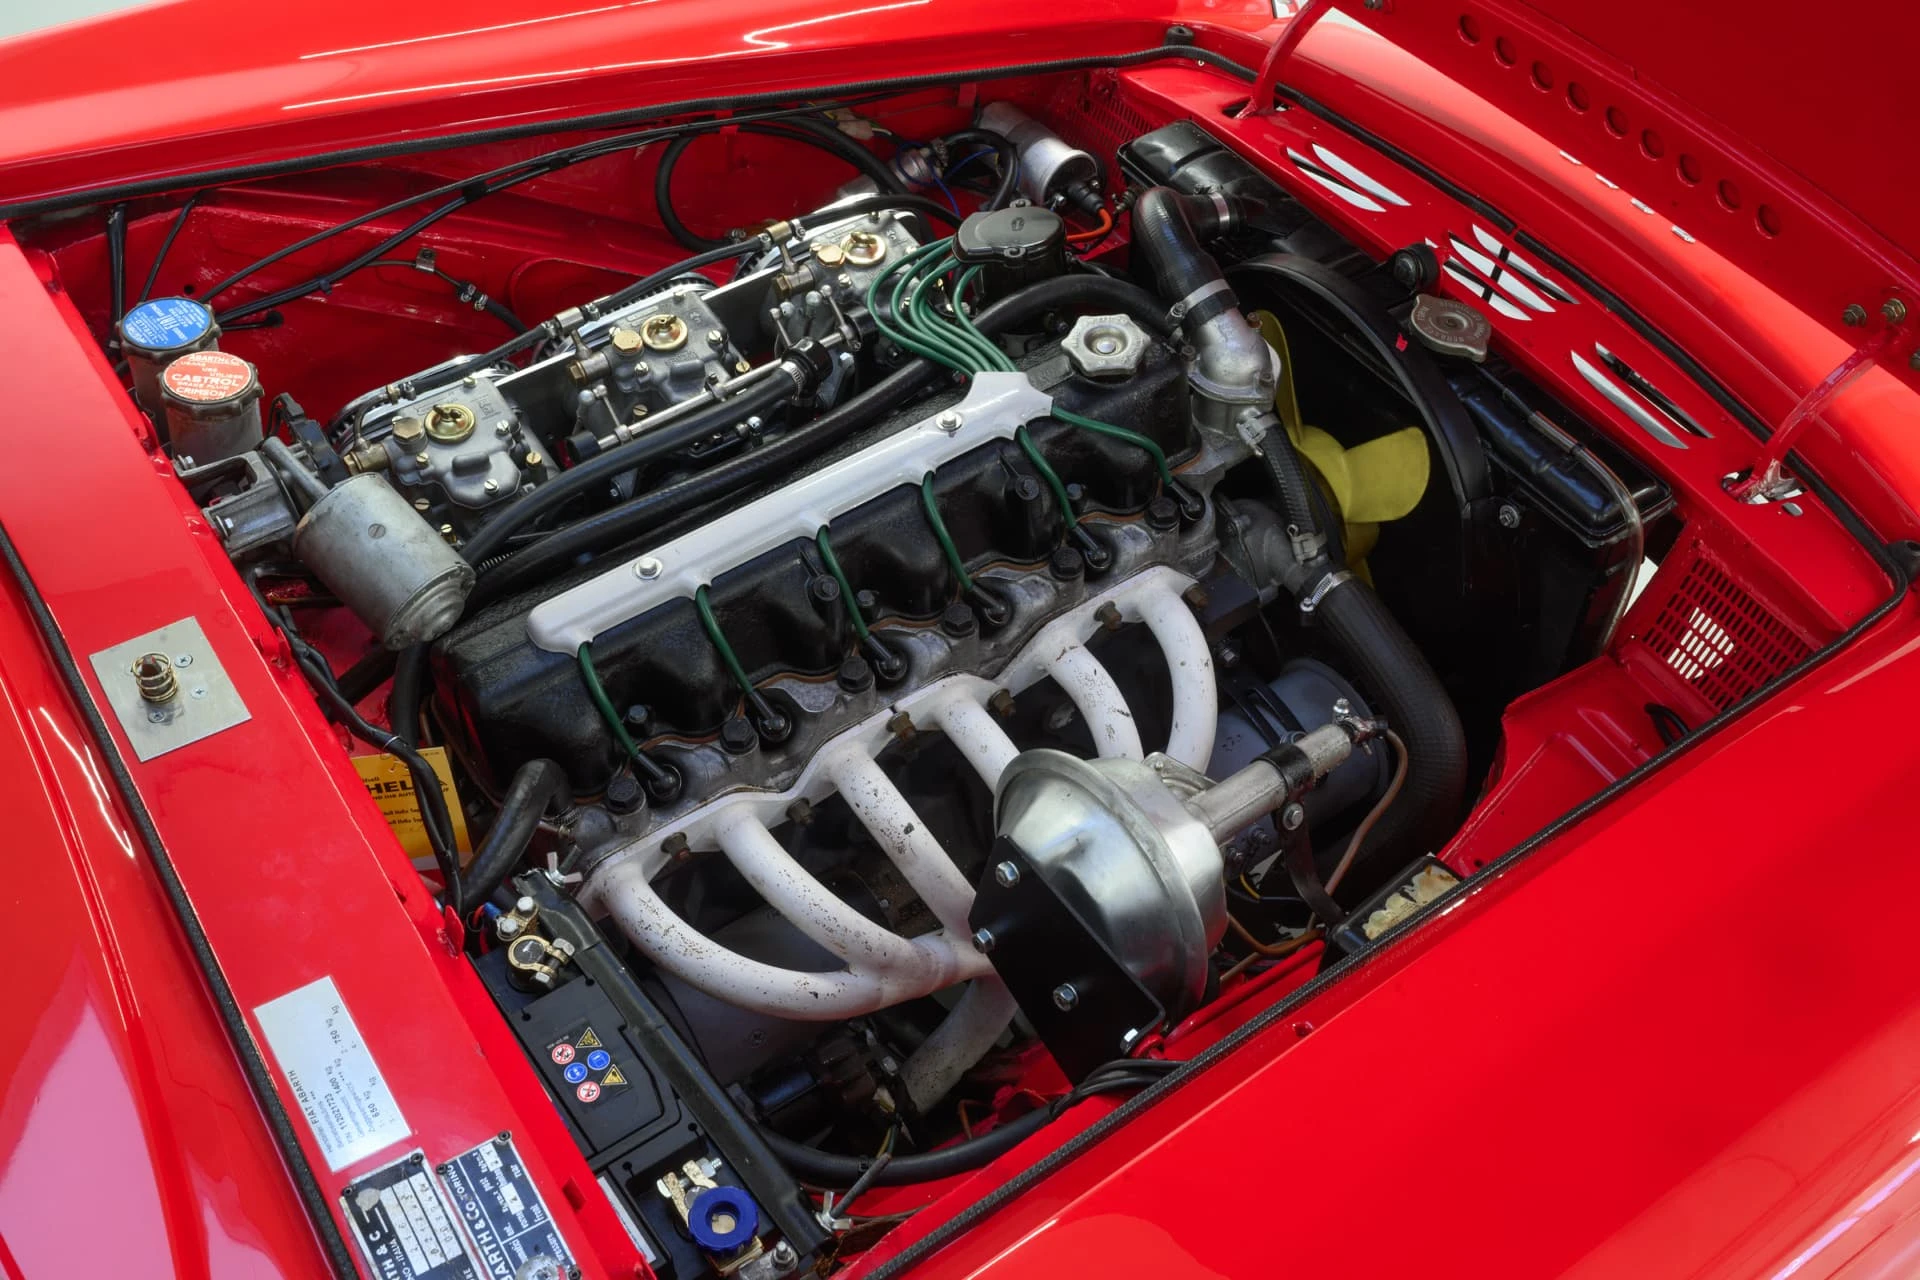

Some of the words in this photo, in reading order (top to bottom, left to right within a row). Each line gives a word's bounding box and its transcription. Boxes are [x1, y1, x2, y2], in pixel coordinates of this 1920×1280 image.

[171, 373, 239, 386] CASTROL
[176, 387, 226, 397] CRIMSON
[330, 1004, 340, 1015] kg
[324, 1017, 335, 1028] kg
[329, 1029, 342, 1044] 750
[323, 1064, 334, 1075] kg
[287, 1069, 309, 1104] ABARTH
[329, 1076, 342, 1094] 1400
[362, 1089, 372, 1100] kg
[304, 1104, 319, 1125] FIAT
[324, 1092, 348, 1130] 112021723
[367, 1101, 380, 1118] 650
[472, 1218, 486, 1231] &
[374, 1243, 389, 1257] &
